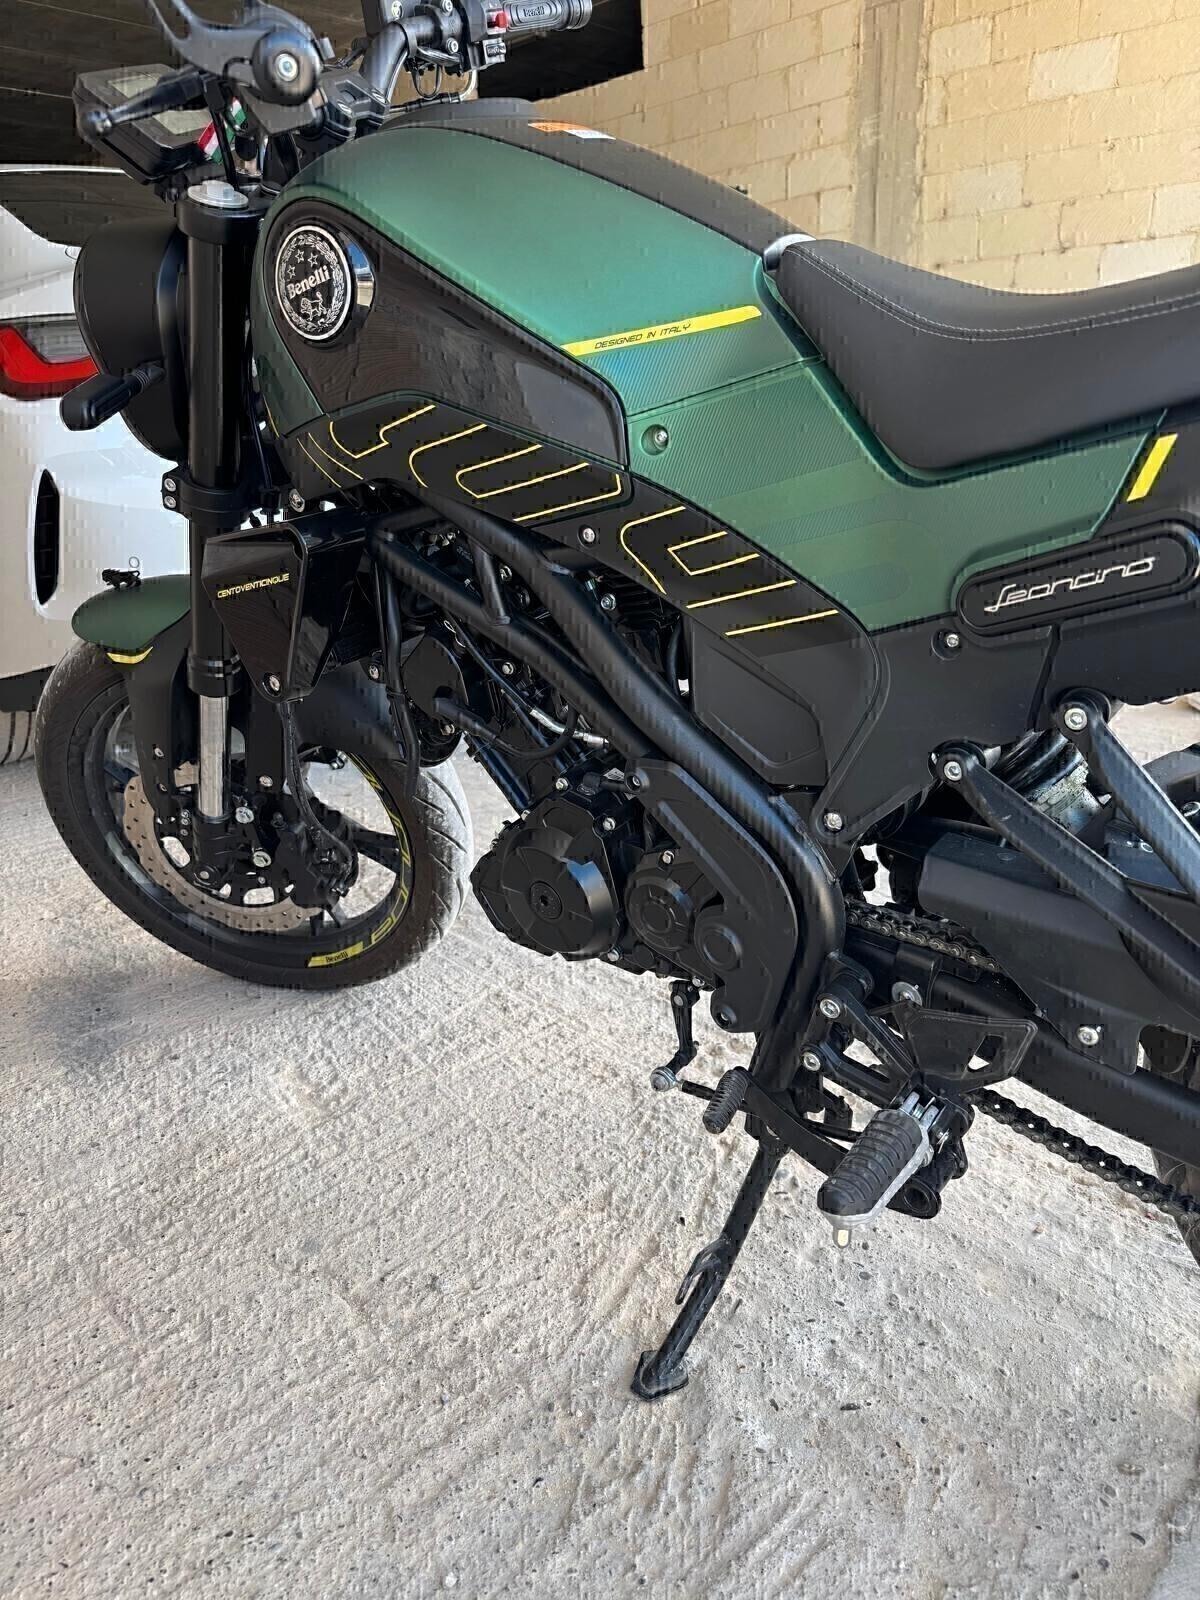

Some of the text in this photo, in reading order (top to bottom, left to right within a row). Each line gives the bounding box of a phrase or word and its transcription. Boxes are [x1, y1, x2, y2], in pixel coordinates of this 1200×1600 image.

[286, 265, 331, 300] Benelli
[594, 323, 692, 350] DESIGNED IN ITALY
[217, 572, 290, 599] CENTOVENTICINQUE
[325, 950, 349, 963] Benelli
